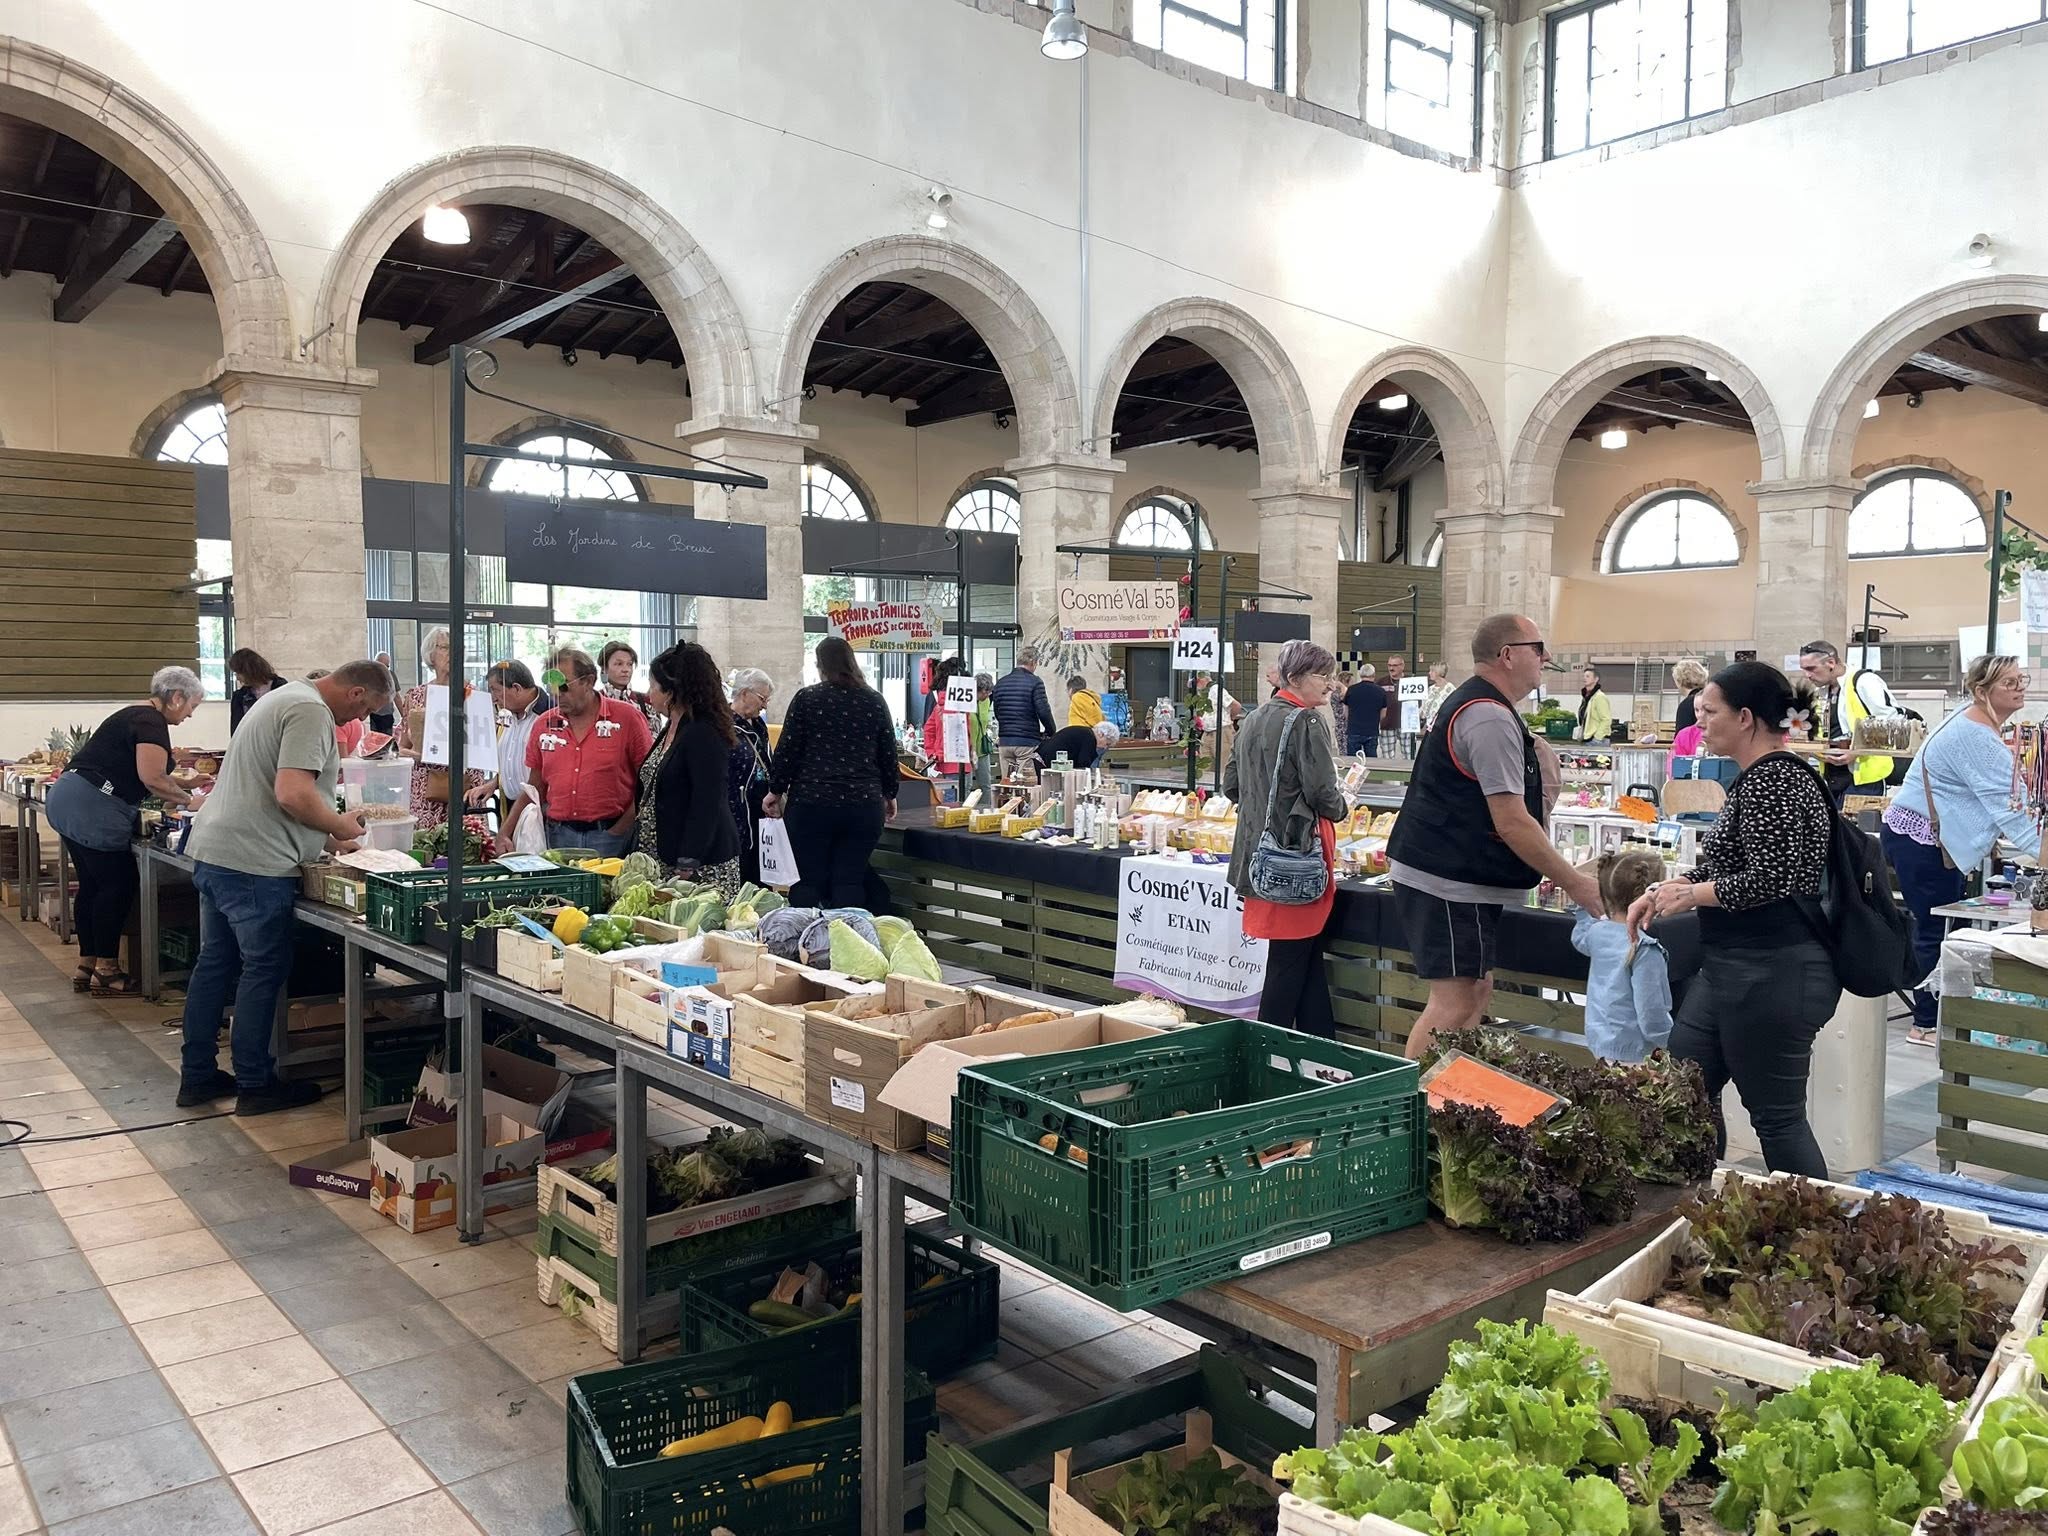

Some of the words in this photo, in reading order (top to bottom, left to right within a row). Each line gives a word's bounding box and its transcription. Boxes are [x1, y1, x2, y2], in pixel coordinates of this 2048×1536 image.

[532, 522, 557, 547] Les
[567, 528, 618, 553] Jardins
[631, 536, 655, 549] de
[1155, 587, 1175, 609] 55
[828, 607, 870, 627] TERROIR
[878, 602, 921, 619] FAMILLES
[842, 621, 889, 642] FROMAGES
[1177, 641, 1213, 658] H24
[948, 687, 973, 702] H25
[1401, 684, 1425, 694] H29
[1127, 870, 1229, 910] Cosmé'Val
[1168, 913, 1211, 935] ETAIN
[1125, 933, 1184, 956] Cosmétiques
[1186, 945, 1222, 965] Visage
[1228, 955, 1262, 975] Corps
[1138, 957, 1191, 981] Fabrication
[1194, 971, 1249, 994] Artisanale
[316, 1174, 360, 1192] Aubergine
[698, 1219, 714, 1230] Van
[714, 1205, 761, 1226] ENGELAND
